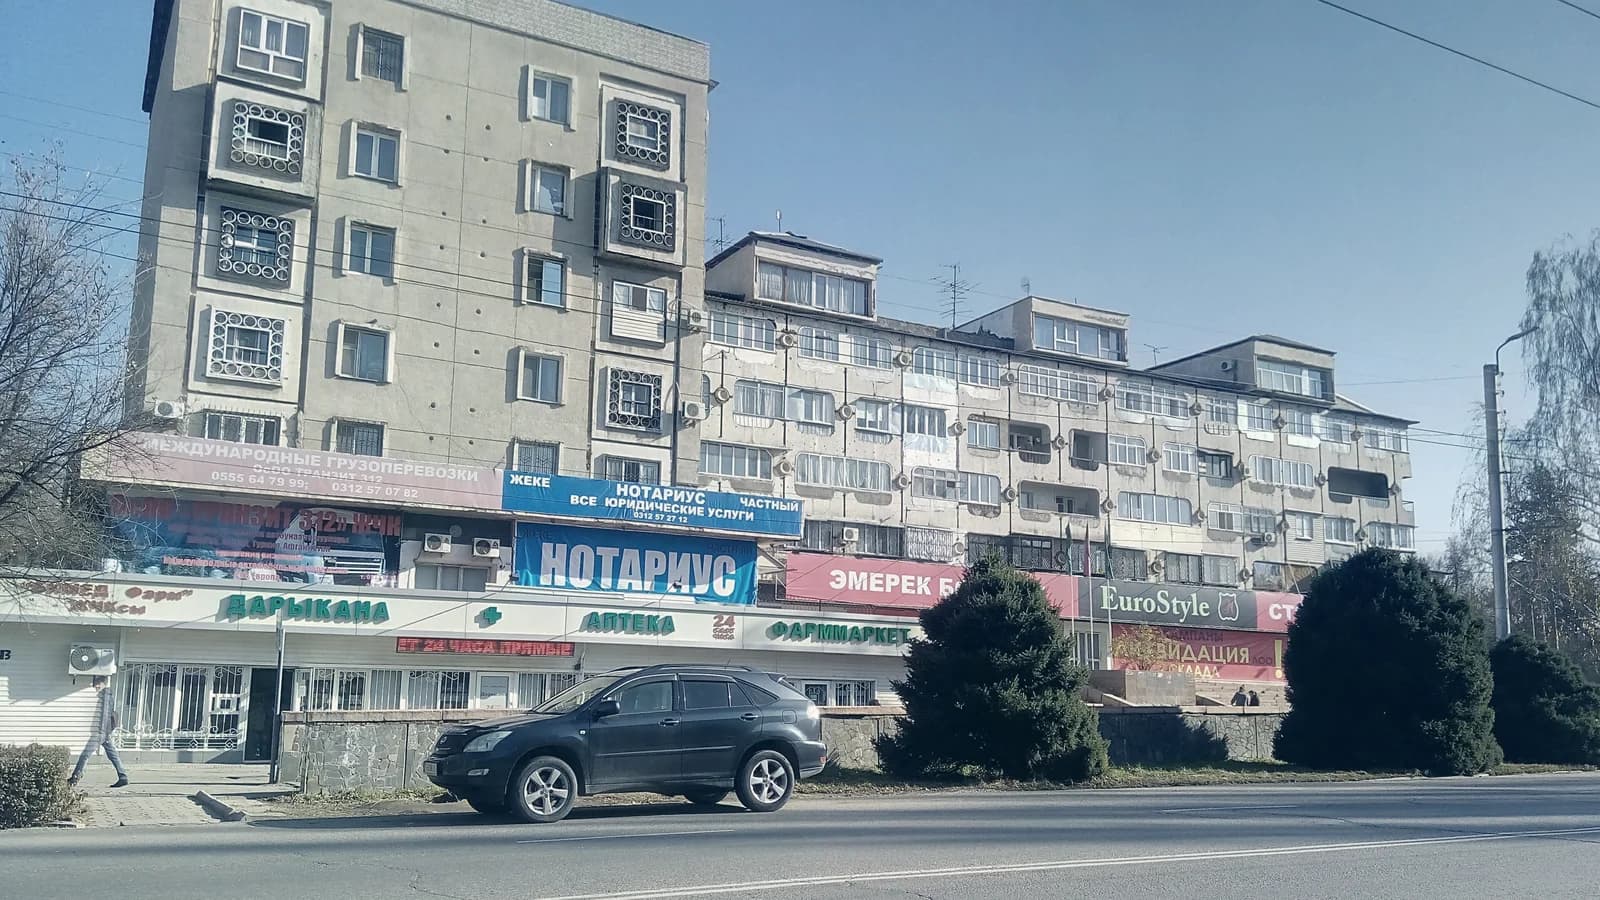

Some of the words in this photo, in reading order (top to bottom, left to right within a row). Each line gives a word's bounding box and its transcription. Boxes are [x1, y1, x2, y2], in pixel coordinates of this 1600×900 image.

[144, 438, 321, 467] МЕЖДУНАРОДНЫЕ
[327, 456, 479, 482] ГРУЗОПЕРЕВОЗКИ
[211, 471, 244, 483] 0555
[248, 474, 265, 485] 64
[269, 476, 285, 487] 79
[332, 482, 363, 493] 0312
[367, 484, 382, 495] 57
[385, 486, 400, 497] 07
[403, 488, 418, 498] 82
[361, 473, 383, 484] 312
[510, 474, 550, 488] ЖЕКЕ
[616, 483, 706, 504] НОТАРИУС
[740, 497, 799, 512] ЧАСТНЫЙ
[570, 494, 598, 507] ВСЕ
[604, 497, 705, 517] ЮРИДИЧЕСКИЕ
[708, 508, 755, 521] УСЛУГИ
[633, 511, 653, 520] 0312
[655, 513, 665, 521] 57
[667, 514, 676, 522] 27
[540, 542, 736, 597] НОТАРИУС
[829, 569, 931, 596] ЭМЕРЕК
[224, 594, 390, 622] ДАРЫКАНА
[1100, 585, 1210, 622] EuroStyle
[1269, 603, 1298, 620] СТ
[586, 611, 675, 633] АПТЕКА
[713, 614, 736, 627] 24
[770, 621, 911, 644] ФАРММАРКЕТ
[423, 639, 445, 653] 24
[450, 640, 495, 654] ЧАСА
